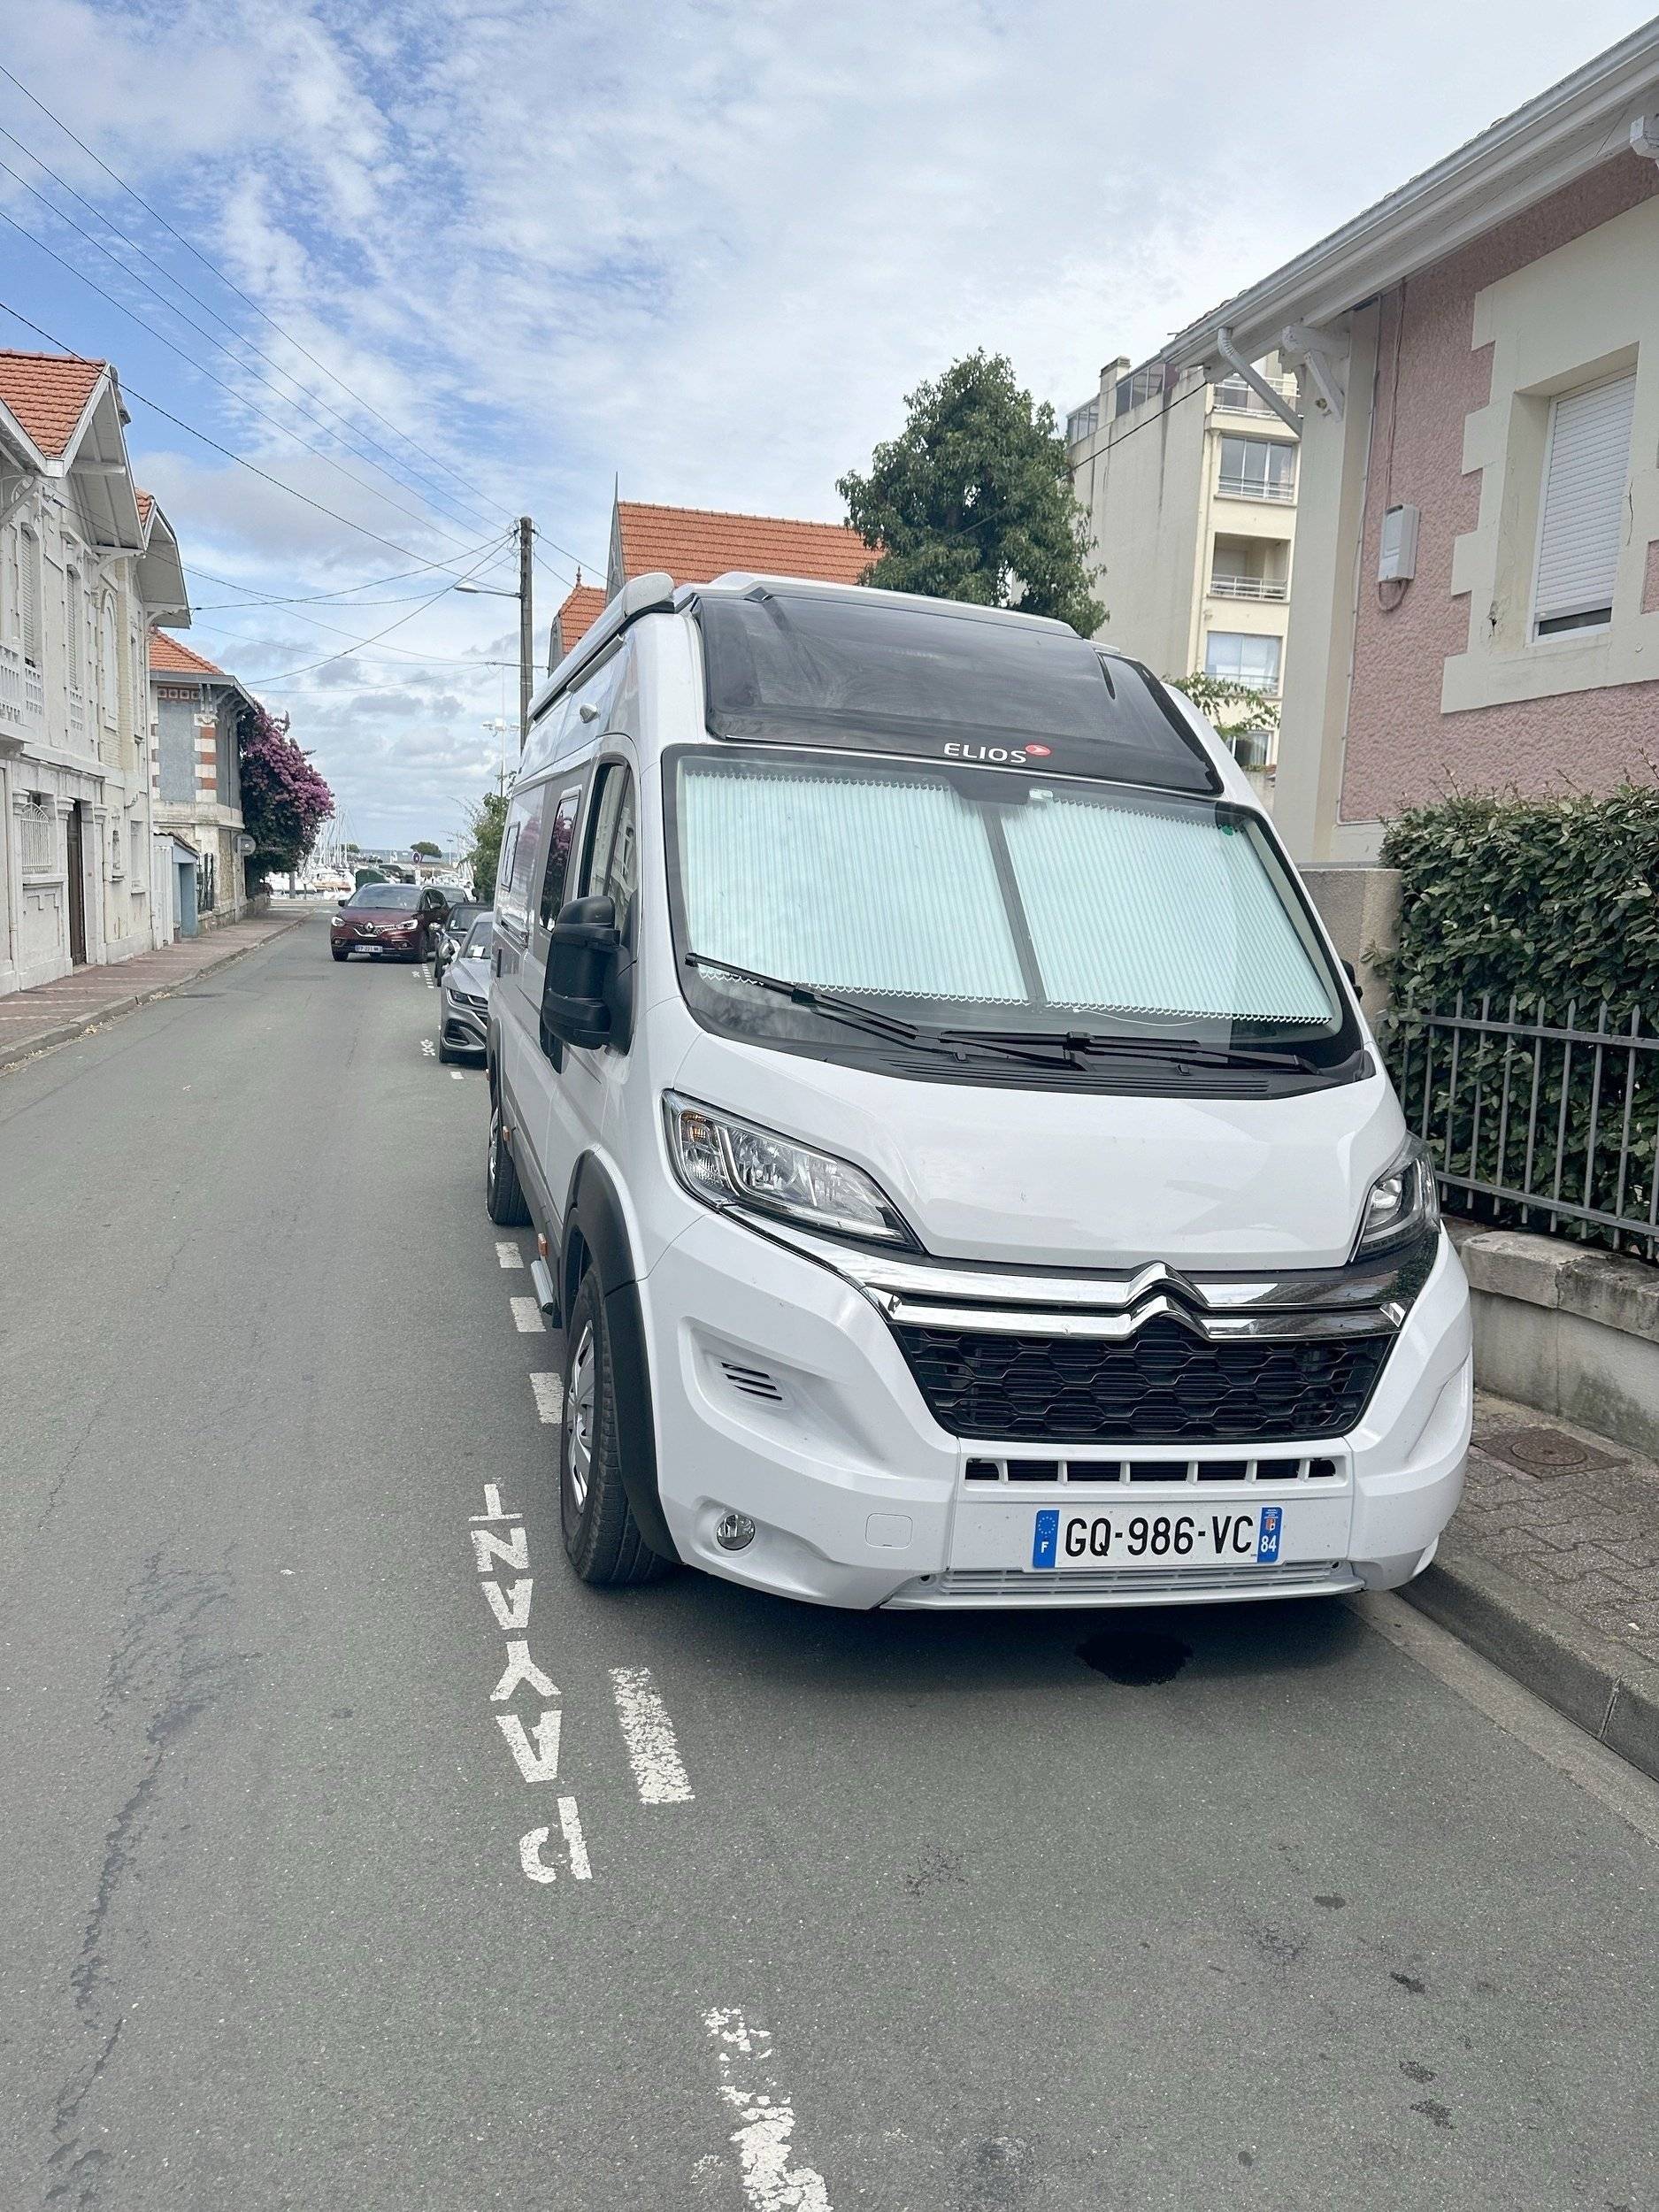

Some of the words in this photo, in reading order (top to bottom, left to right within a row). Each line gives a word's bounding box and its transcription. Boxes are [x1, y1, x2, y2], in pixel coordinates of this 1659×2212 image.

[943, 742, 1027, 764] ELIOS
[1064, 1515, 1255, 1557] GQ-986-VC
[1260, 1535, 1277, 1553] 84
[1041, 1540, 1049, 1554] F
